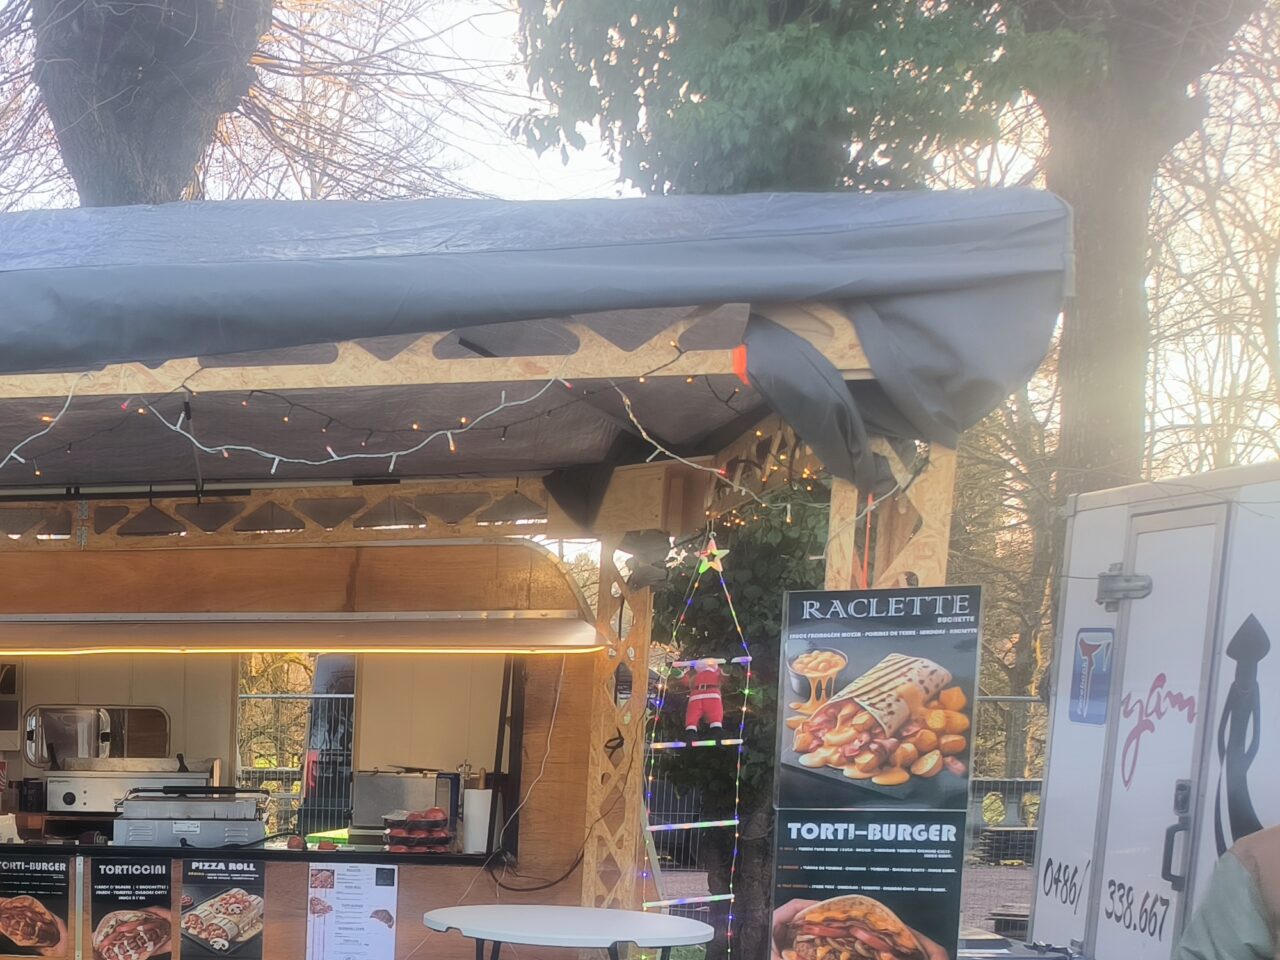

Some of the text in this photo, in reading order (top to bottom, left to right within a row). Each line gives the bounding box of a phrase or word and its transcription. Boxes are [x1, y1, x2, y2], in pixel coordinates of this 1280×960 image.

[802, 594, 970, 619] RACLETTE
[788, 823, 956, 841] TORTI-BURGER
[99, 865, 166, 874] TORTICCINI
[192, 862, 256, 871] PIZZA ROLL
[1043, 858, 1170, 942] 0486/ 338.667
